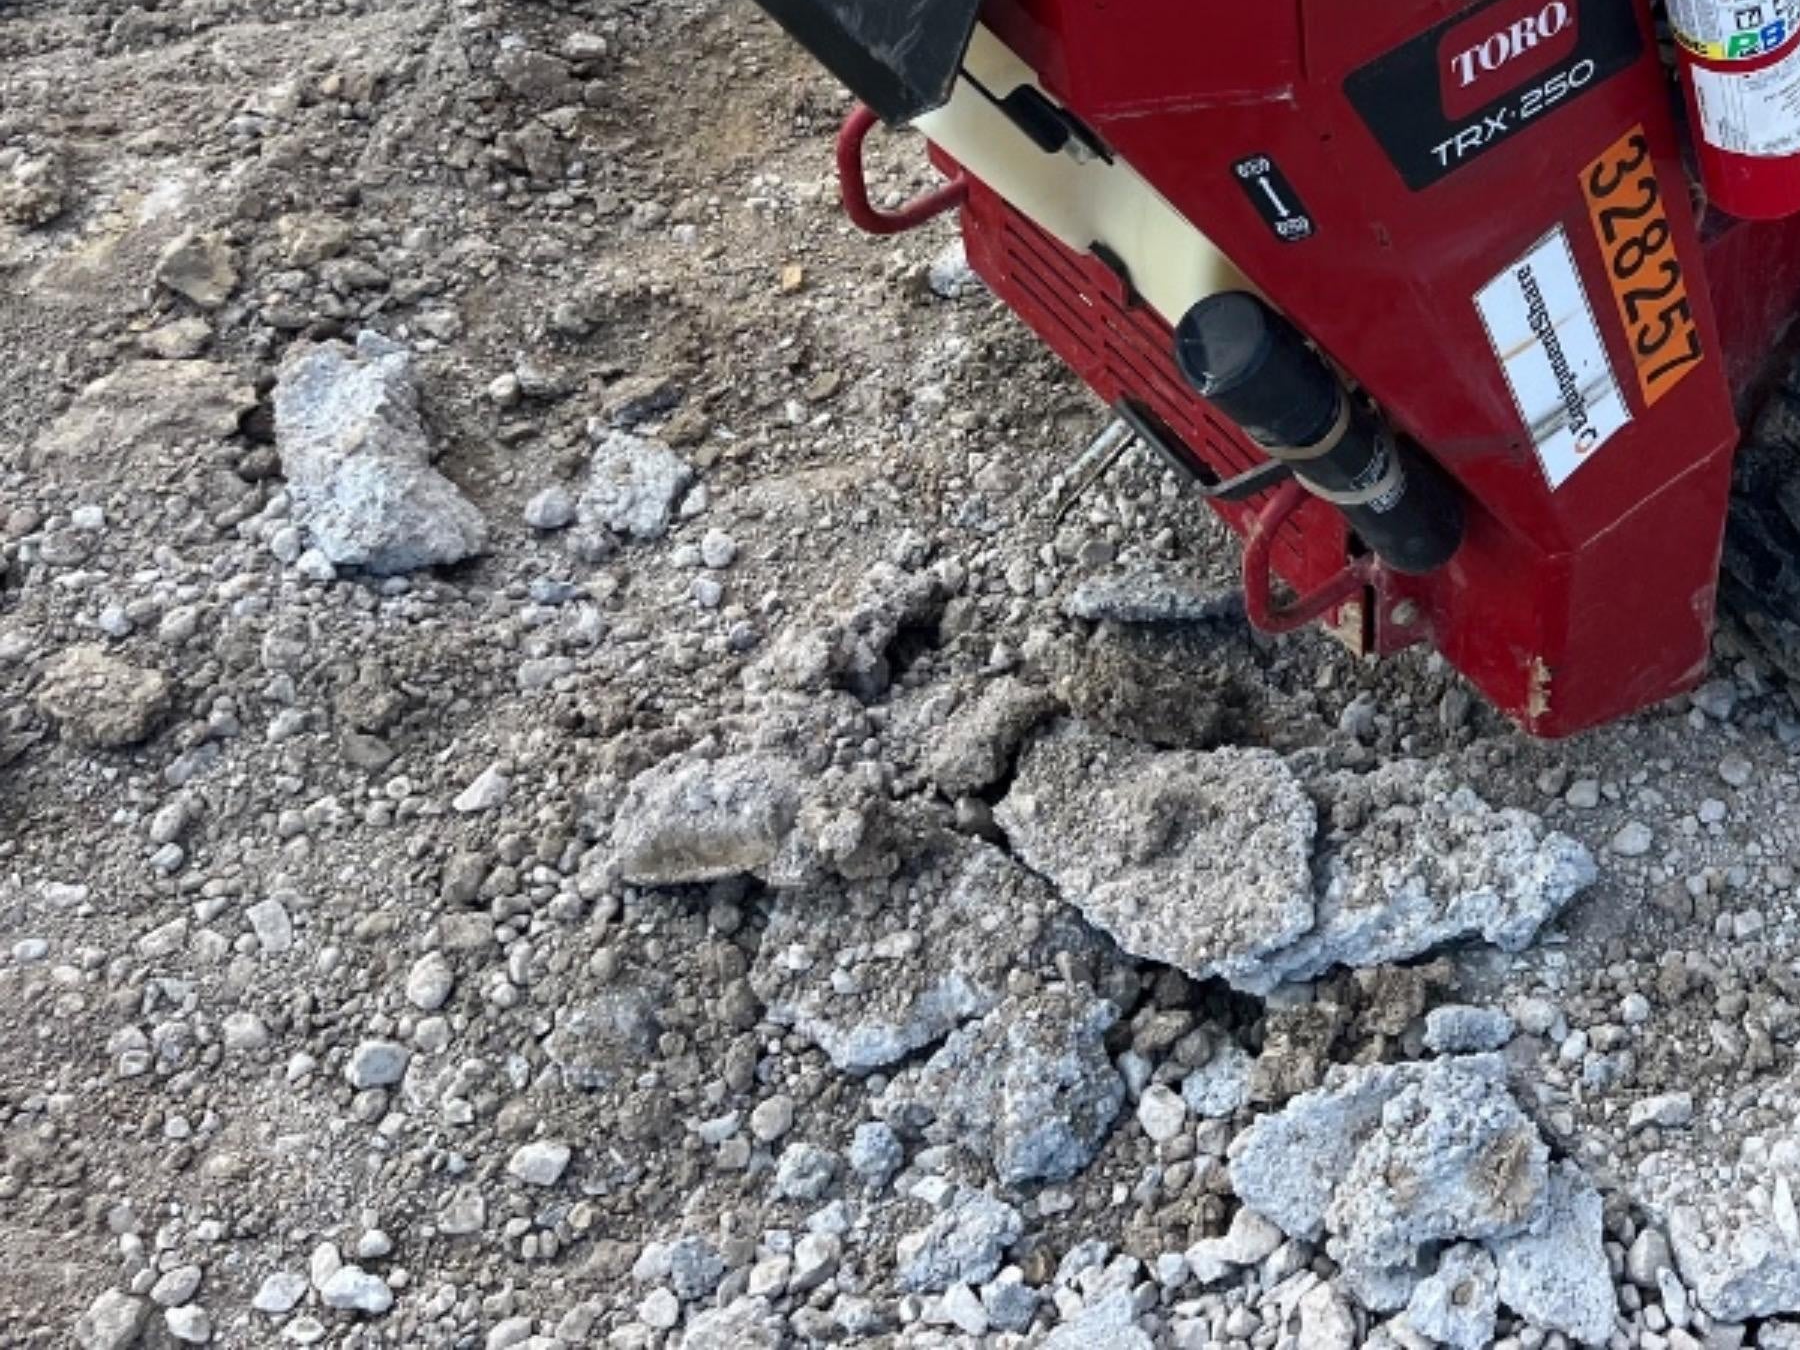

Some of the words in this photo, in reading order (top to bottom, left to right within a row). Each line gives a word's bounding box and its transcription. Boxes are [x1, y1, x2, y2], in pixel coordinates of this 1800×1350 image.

[1451, 1, 1568, 88] TORO
[1589, 133, 1702, 386] 328257
[1516, 262, 1589, 436] EquipmentShare
